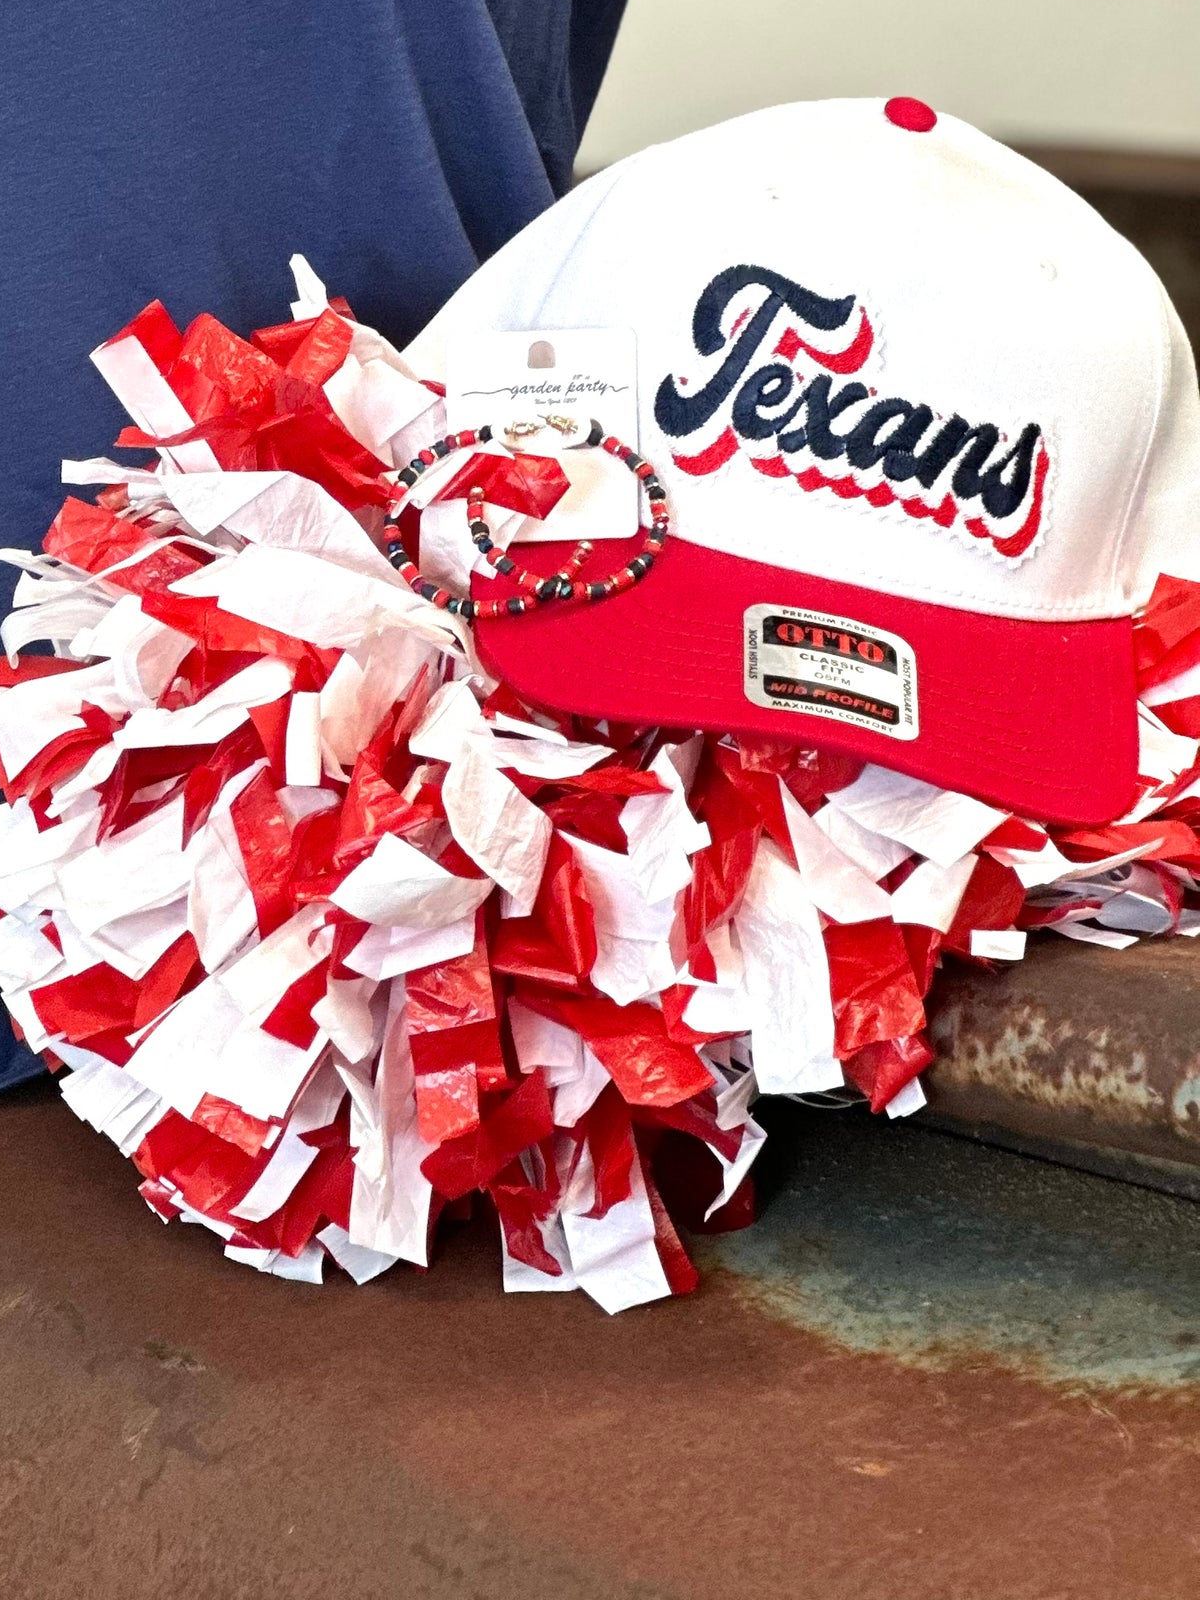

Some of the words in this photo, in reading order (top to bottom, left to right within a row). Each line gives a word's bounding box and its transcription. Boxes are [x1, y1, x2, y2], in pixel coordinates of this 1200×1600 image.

[508, 380, 562, 400] garden
[564, 380, 609, 396] party
[654, 264, 1042, 519] Texans
[782, 608, 837, 625] PREMIUM
[748, 628, 759, 650] LOOK
[776, 622, 885, 664] OTTO
[748, 651, 759, 680] STYLISH
[799, 652, 865, 674] CLASSIC
[821, 664, 844, 676] FIT
[901, 656, 911, 678] MOST
[769, 681, 809, 696] MID
[813, 688, 895, 720] PROFILE
[902, 678, 913, 714] POPULAR
[771, 699, 834, 716] MAXIMUM
[838, 711, 894, 734] COMFORT
